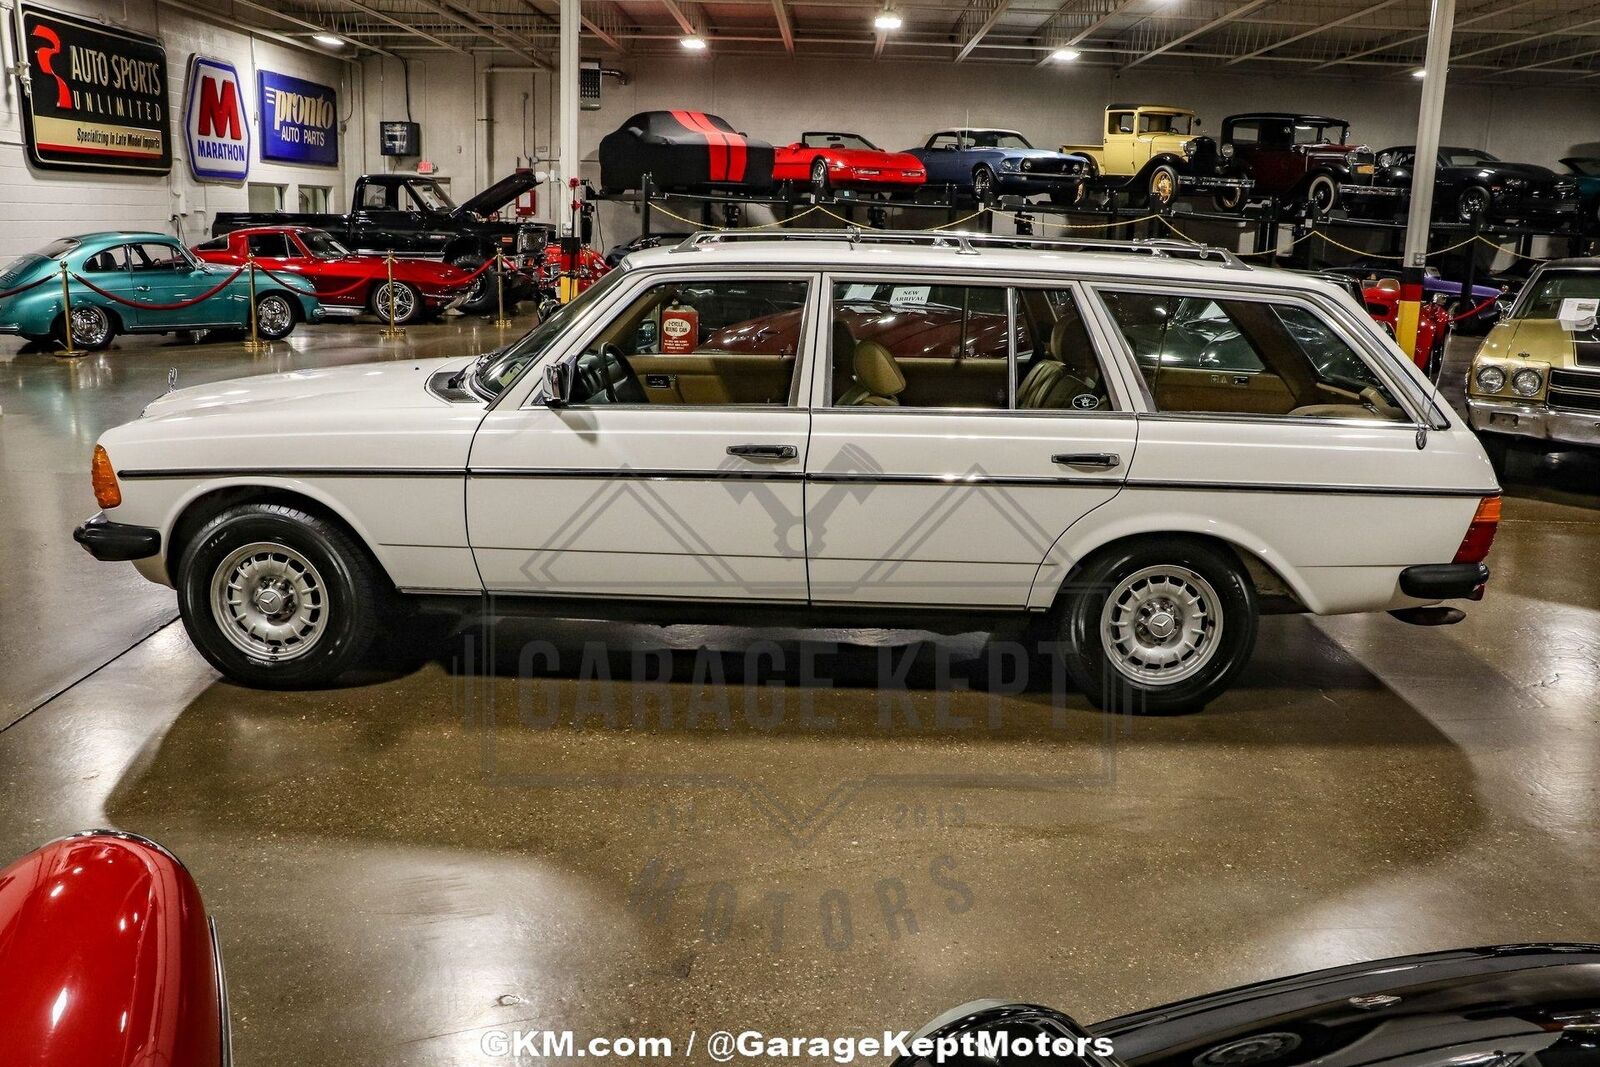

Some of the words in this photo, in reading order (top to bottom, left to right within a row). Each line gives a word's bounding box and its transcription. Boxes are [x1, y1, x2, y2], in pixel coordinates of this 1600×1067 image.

[70, 45, 109, 87] AUTO
[112, 54, 160, 96] SPORTS
[73, 90, 160, 122] UNLIMITED
[198, 75, 242, 141] M
[274, 89, 333, 131] pronto
[198, 140, 245, 161] MARATHON
[281, 126, 300, 142] AUTO
[304, 129, 325, 147] PARTS
